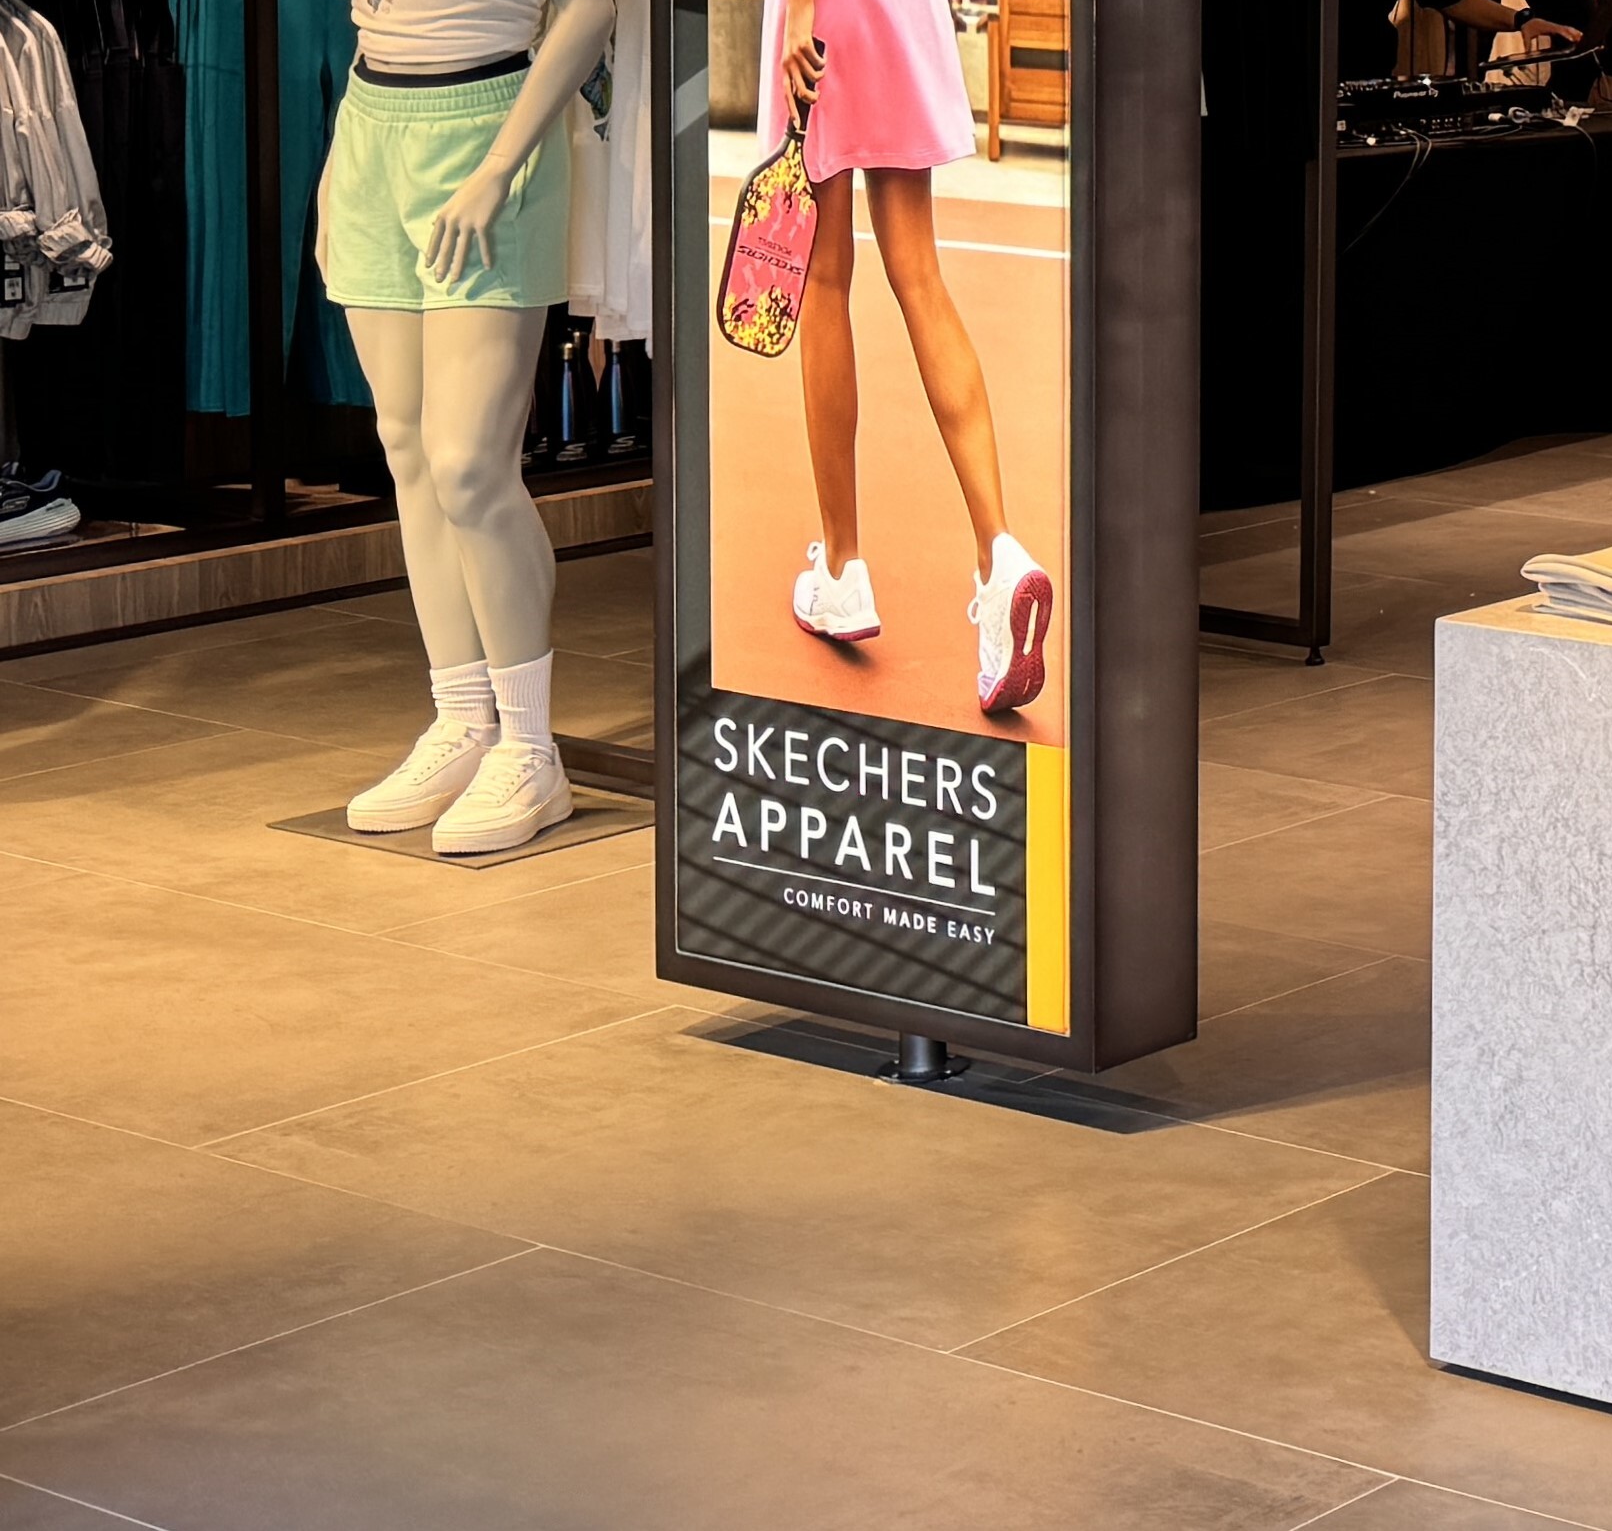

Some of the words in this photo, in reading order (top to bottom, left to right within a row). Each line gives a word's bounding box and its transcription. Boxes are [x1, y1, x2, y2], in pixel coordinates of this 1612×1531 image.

[713, 717, 998, 821] SKECHERS
[712, 792, 996, 897] APPAREL
[783, 887, 873, 921] COMFORT
[882, 906, 938, 935] MADE
[946, 919, 996, 947] EASY
